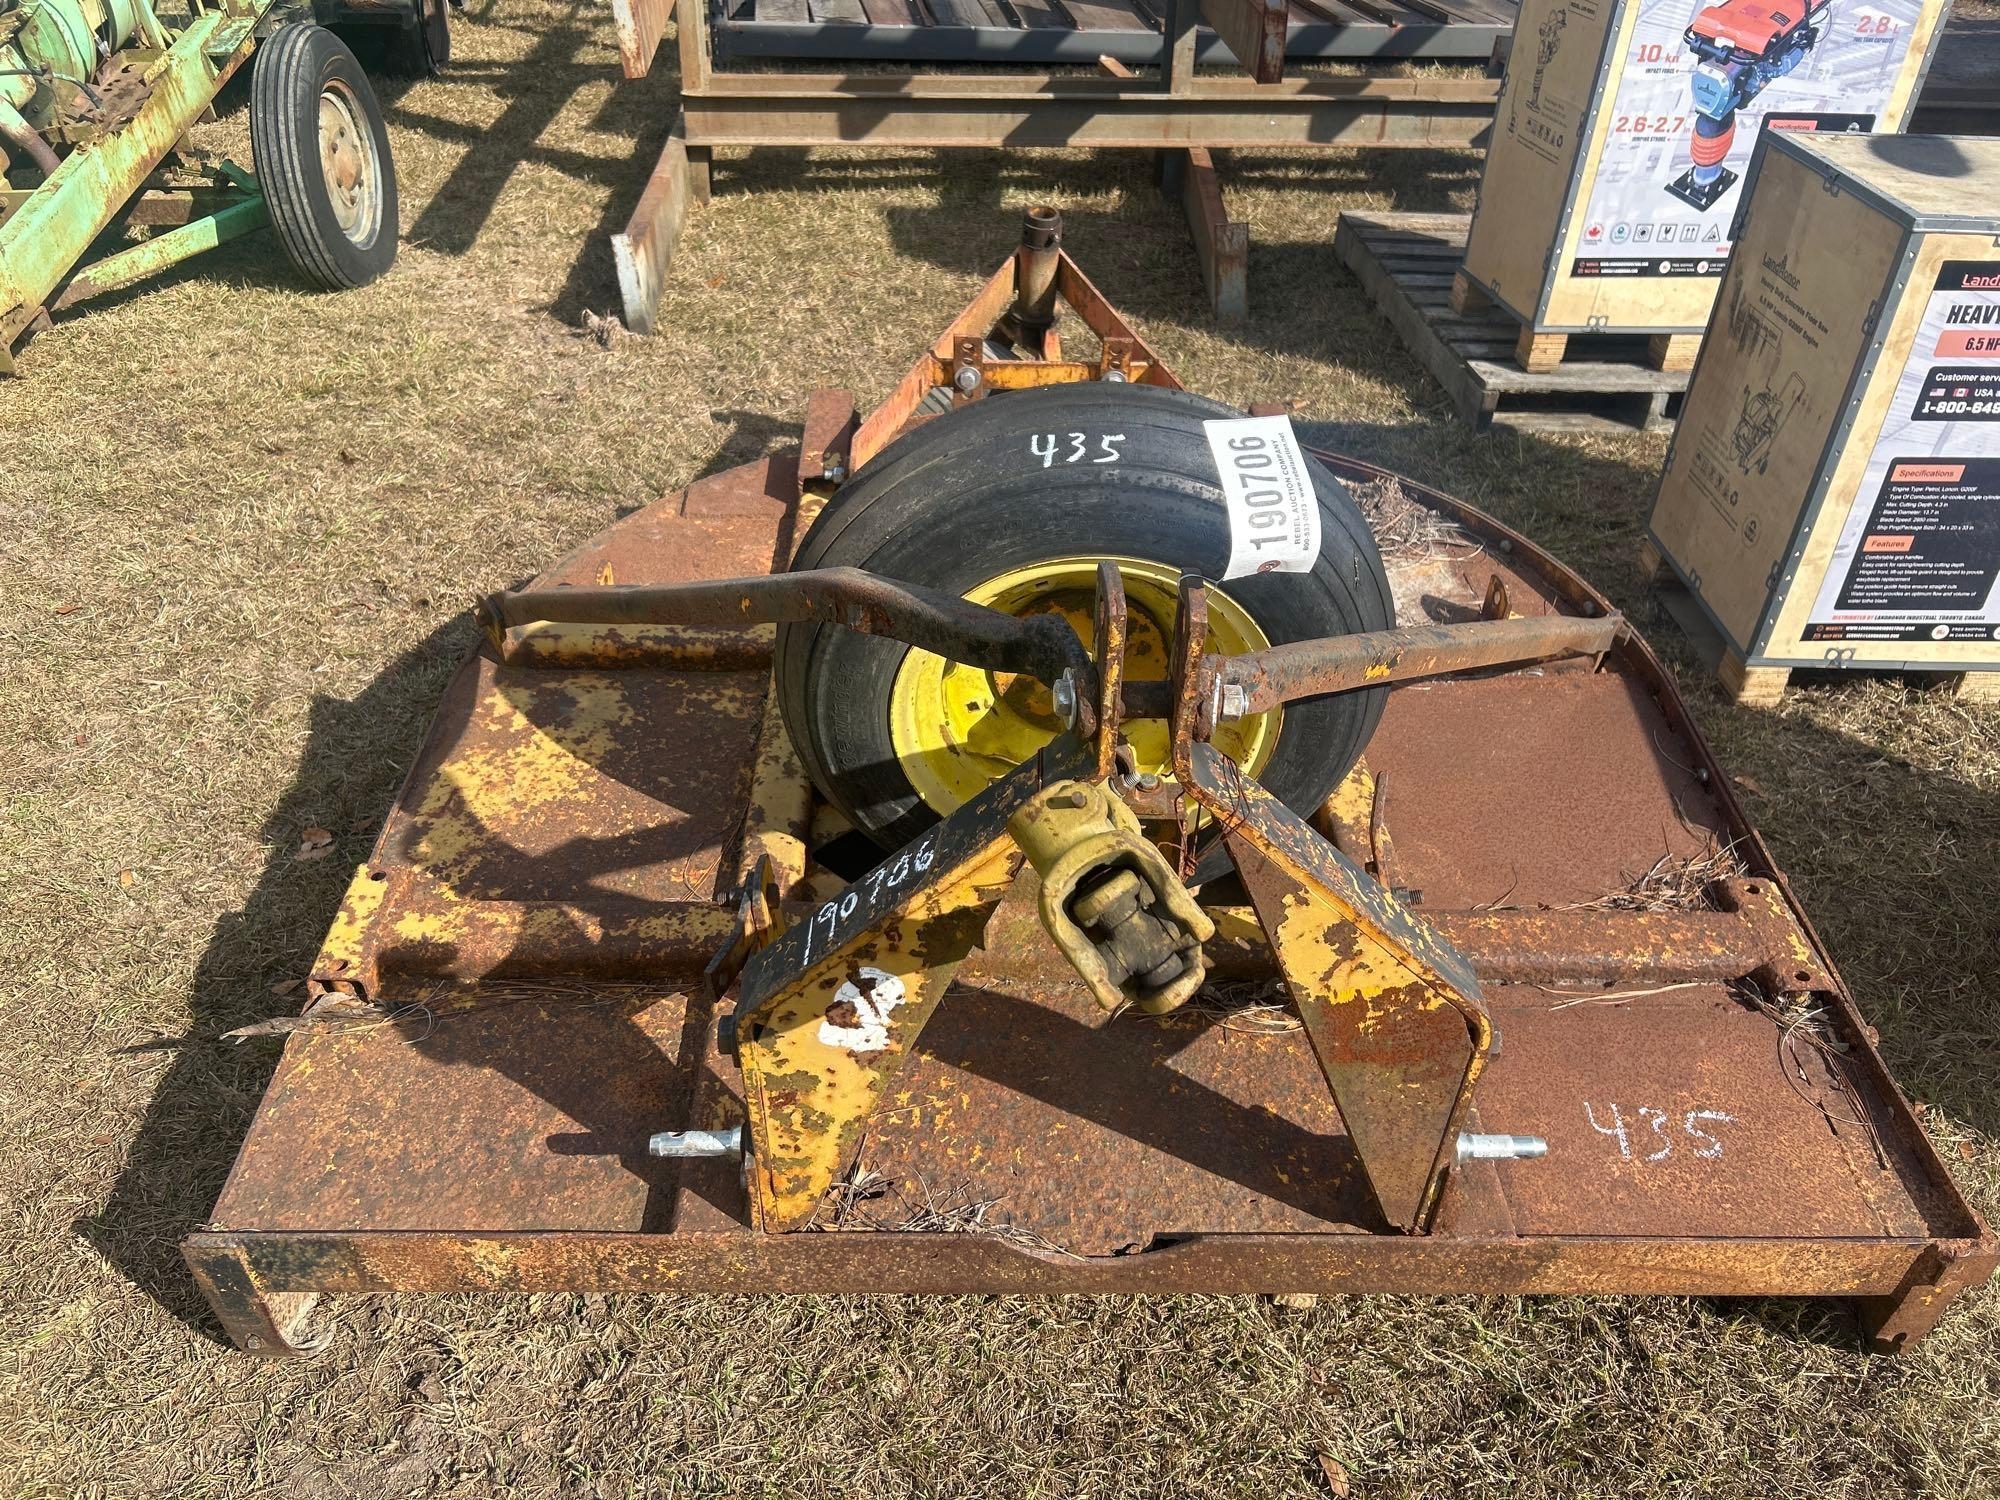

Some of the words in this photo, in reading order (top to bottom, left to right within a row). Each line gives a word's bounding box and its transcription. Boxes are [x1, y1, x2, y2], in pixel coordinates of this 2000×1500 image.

[1856, 15, 1891, 33] 2.8
[1637, 44, 1662, 63] 10
[1615, 116, 1684, 133] 2.6-2.7
[1762, 252, 1800, 291] LandHonor
[1962, 274, 2000, 287] Land
[1785, 296, 1805, 316] Concrete
[1806, 311, 1818, 326] Floor
[1818, 321, 1829, 334] Saw
[1803, 330, 1819, 348] Engine
[1965, 338, 1984, 351] 6.5
[1936, 373, 1979, 382] Customer
[1974, 389, 1993, 397] USA
[1030, 433, 1126, 467] 435
[1271, 439, 1289, 475] COMPANY
[1278, 432, 1305, 498] www.rebelauction.net
[1899, 470, 1954, 478] Specifications
[1227, 436, 1288, 551] 190706
[1285, 477, 1299, 513] AUCTION
[1293, 516, 1301, 544] REBEL
[1583, 1102, 1738, 1161] 435
